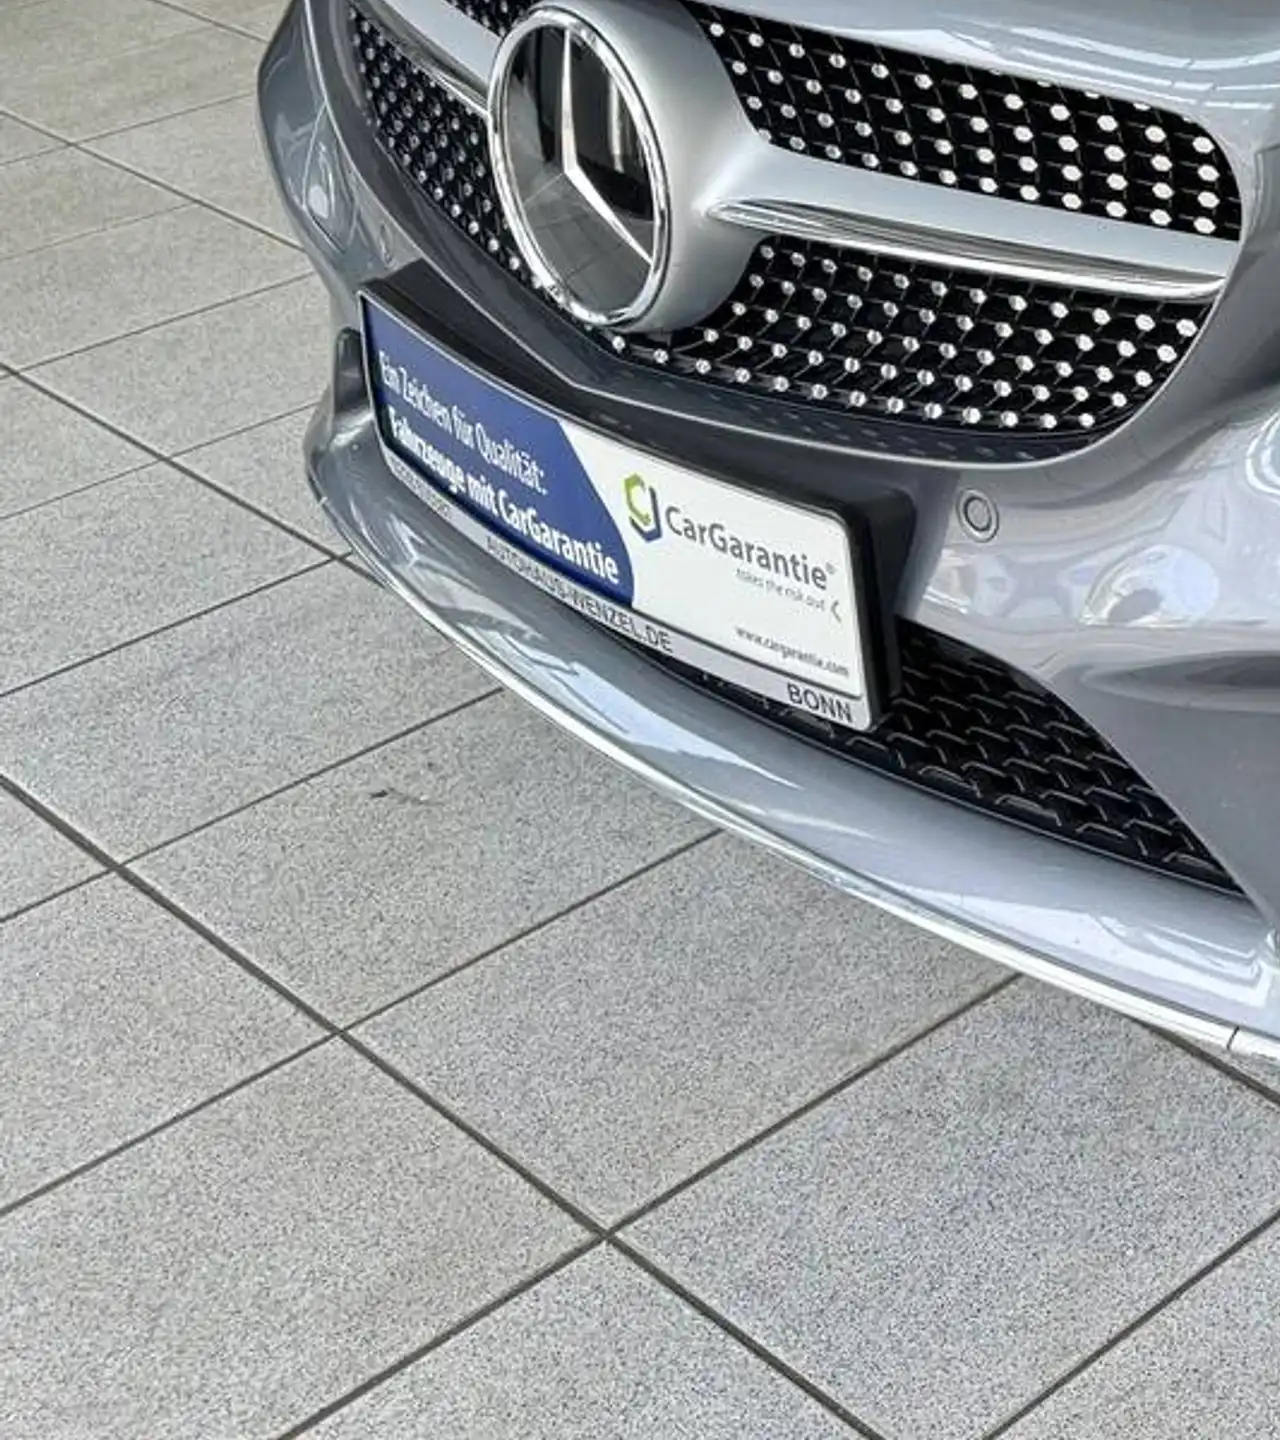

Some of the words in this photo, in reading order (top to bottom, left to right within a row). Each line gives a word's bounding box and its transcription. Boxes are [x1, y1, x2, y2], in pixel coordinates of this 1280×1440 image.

[378, 349, 401, 396] Ein
[400, 366, 452, 435] Zeichen
[450, 404, 475, 450] für
[474, 422, 549, 496] Qualität:
[388, 404, 466, 492] Fahrzeuge
[466, 472, 499, 517] mit
[498, 489, 620, 585] CarGarantie
[786, 682, 854, 723] BONN
